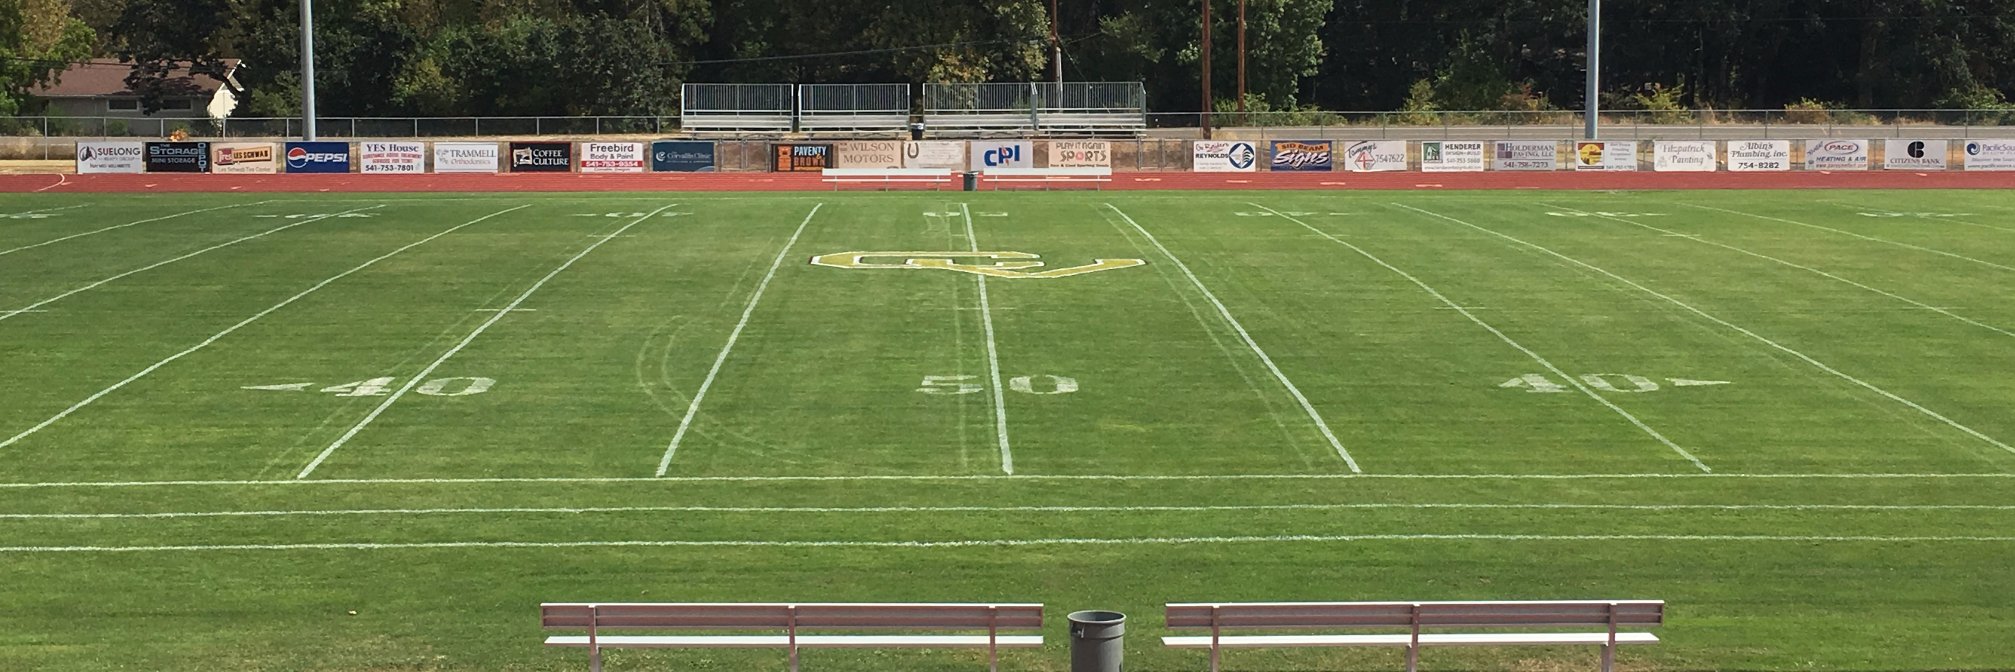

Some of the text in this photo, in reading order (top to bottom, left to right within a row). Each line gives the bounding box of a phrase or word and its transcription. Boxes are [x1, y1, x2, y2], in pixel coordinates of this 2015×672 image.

[366, 143, 420, 152] YES House
[590, 143, 634, 153] Freebird
[793, 145, 827, 156] PAVENTY
[850, 142, 895, 152] WILSON
[1055, 142, 1106, 150] PLAY IT AGAIN
[1444, 143, 1482, 151] HENDERER
[1505, 143, 1555, 151] HOLDERMAN
[1662, 143, 1706, 155] Fitzpatrick
[1739, 141, 1774, 151] Albin's
[97, 147, 140, 156] SUELONG
[243, 150, 269, 159] SCHWAB
[450, 149, 497, 158] TRAMMELL
[532, 149, 563, 158] COFFEE
[984, 144, 1020, 167] CPI
[1059, 150, 1107, 162] SPORTS
[305, 152, 348, 163] PEPSI
[532, 157, 570, 166] CULTURE
[590, 153, 609, 161] Body
[793, 156, 826, 167] BROWN
[843, 153, 895, 164] MOTORS
[1273, 149, 1329, 169] Signs
[1672, 154, 1705, 166] Painting
[365, 164, 414, 172] 541-753-7801
[1738, 161, 1780, 169] 754-8282
[319, 376, 497, 397] 40
[915, 374, 1079, 395] 50
[1498, 373, 1660, 393] 40
